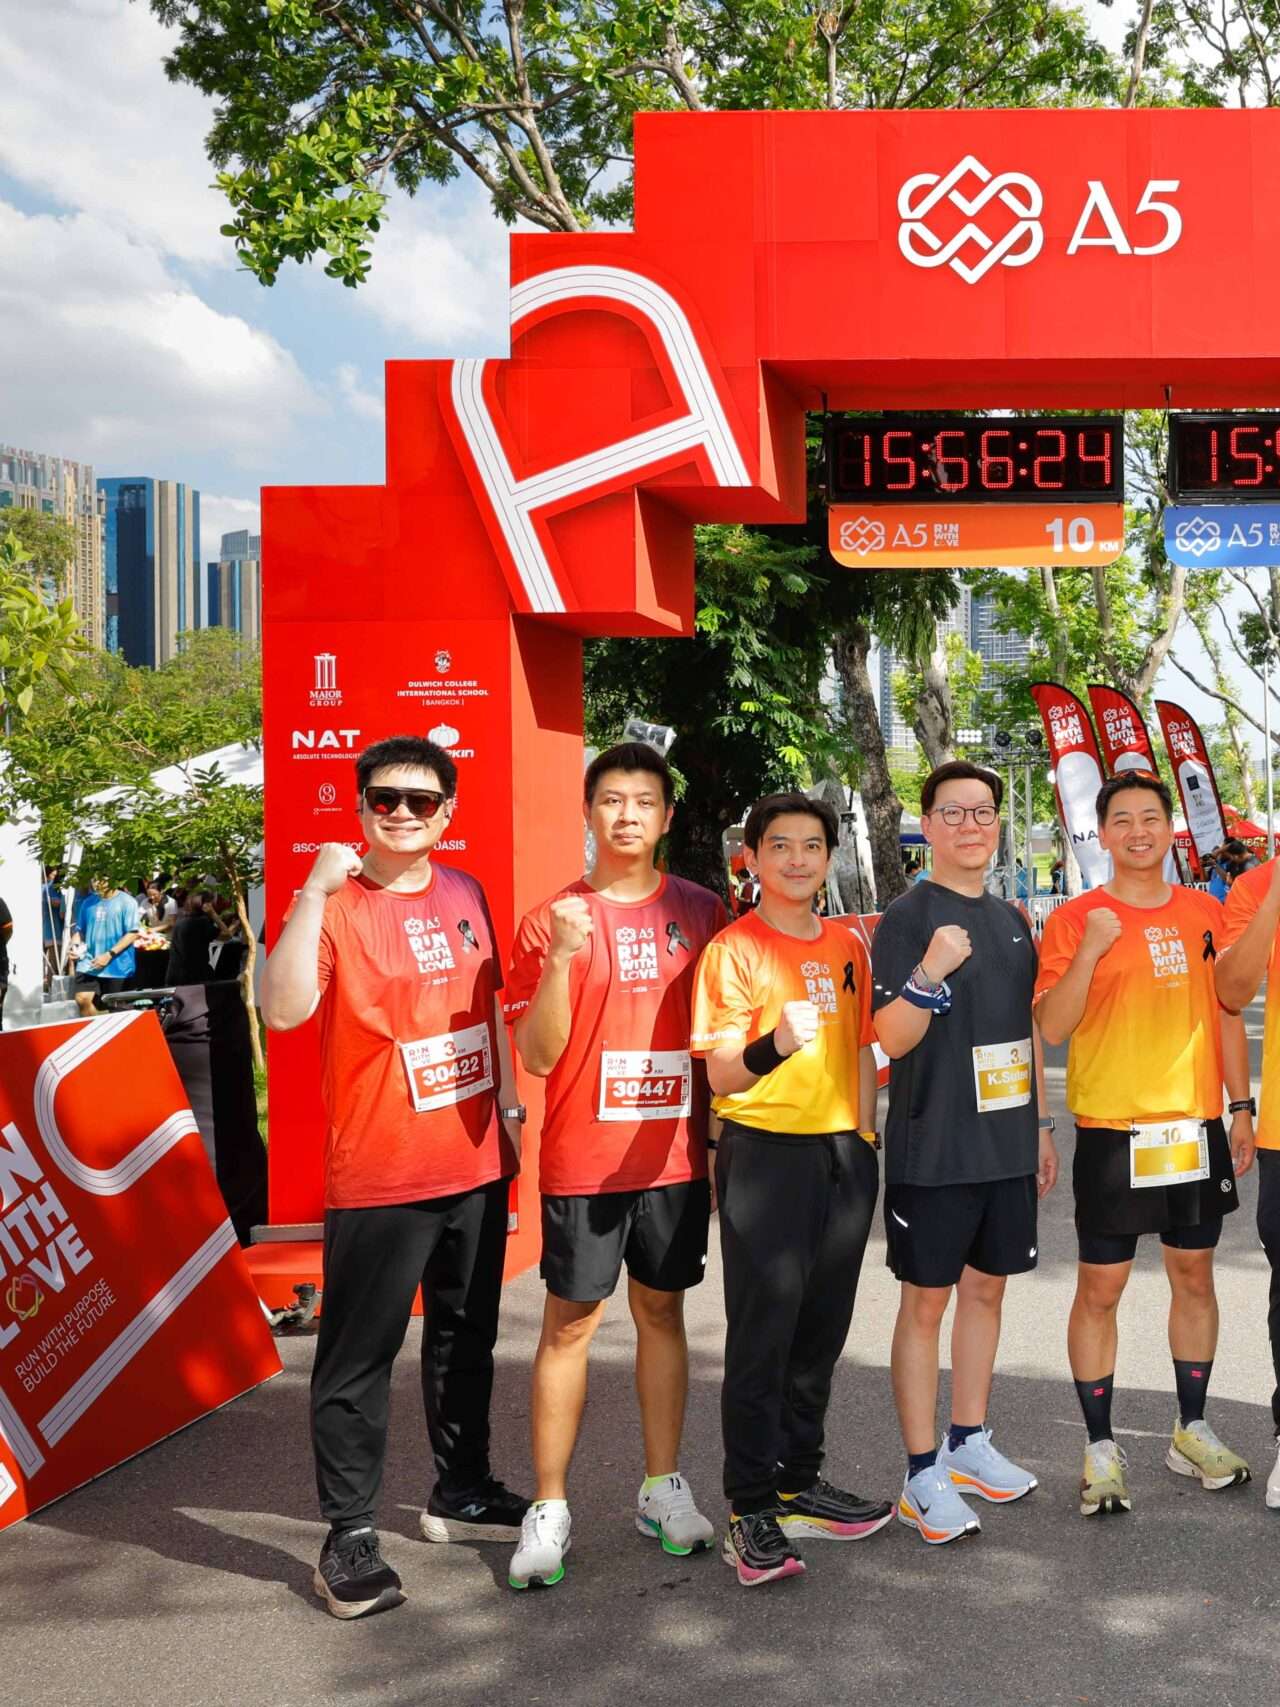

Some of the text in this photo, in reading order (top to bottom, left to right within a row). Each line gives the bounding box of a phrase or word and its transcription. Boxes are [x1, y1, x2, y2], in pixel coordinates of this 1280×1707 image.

[1067, 179, 1182, 255] A5
[863, 430, 1111, 489] 15:56:24
[891, 523, 928, 547] A5
[933, 523, 959, 533] RUN
[1045, 517, 1119, 552] 10 KM
[1226, 523, 1264, 547] A5
[309, 690, 343, 699] MAJOR
[397, 689, 456, 697] INTERNATIONAL
[1051, 714, 1080, 731] RUN
[1105, 717, 1132, 734] RUN
[292, 729, 361, 749] NAT
[1072, 830, 1099, 845] NA
[408, 931, 448, 950] RUN
[1148, 940, 1185, 956] RUN
[617, 942, 656, 960] RUN
[619, 958, 658, 970] WITH
[1152, 953, 1187, 967] WITH
[443, 1041, 457, 1056] 3
[1010, 1048, 1020, 1065] 3
[422, 1056, 479, 1086] 30422
[641, 1059, 653, 1074] 3
[612, 1080, 676, 1098] 30447
[1161, 1127, 1181, 1144] 10
[15, 1277, 110, 1380] RUN WITH PURPOSE
[22, 1289, 117, 1393] BUILD THE FUTURE
